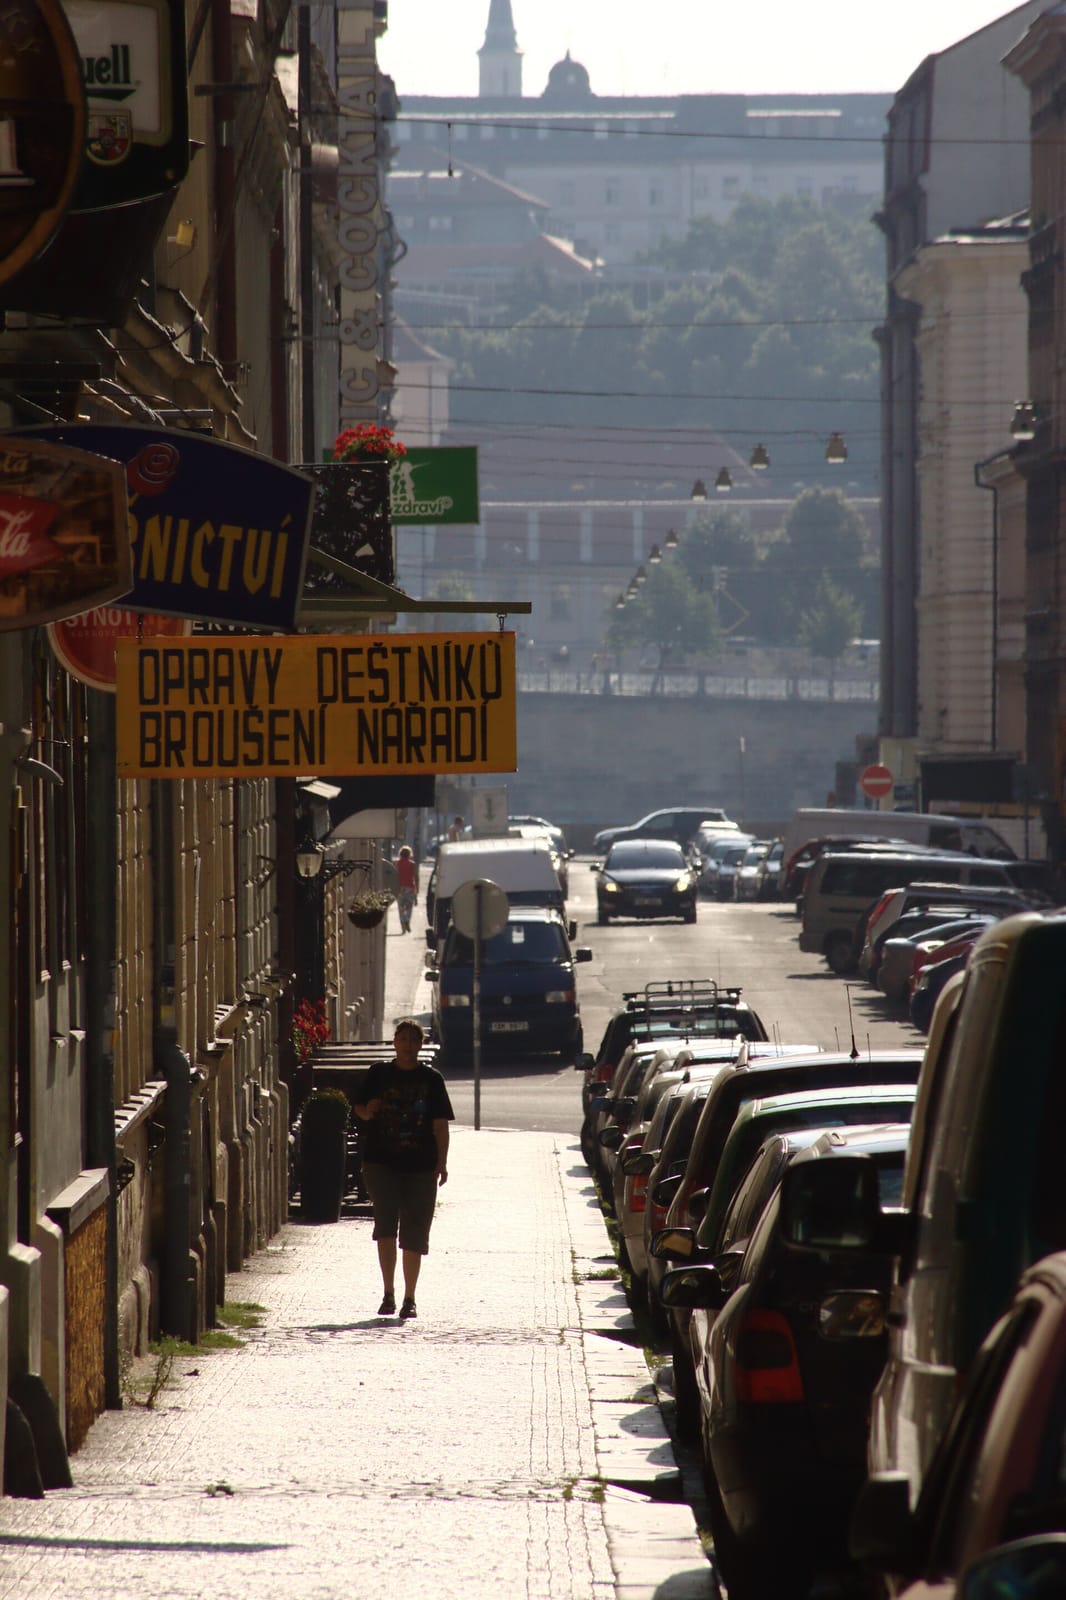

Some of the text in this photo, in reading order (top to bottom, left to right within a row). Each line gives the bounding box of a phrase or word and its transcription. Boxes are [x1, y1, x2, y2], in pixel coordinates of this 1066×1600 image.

[337, 26, 379, 431] IC & COCKTAIL
[138, 640, 503, 705] OPRAVY DEŠTNÍKŮ
[139, 699, 490, 768] BROUŠENÍ NÁŘADÍ
